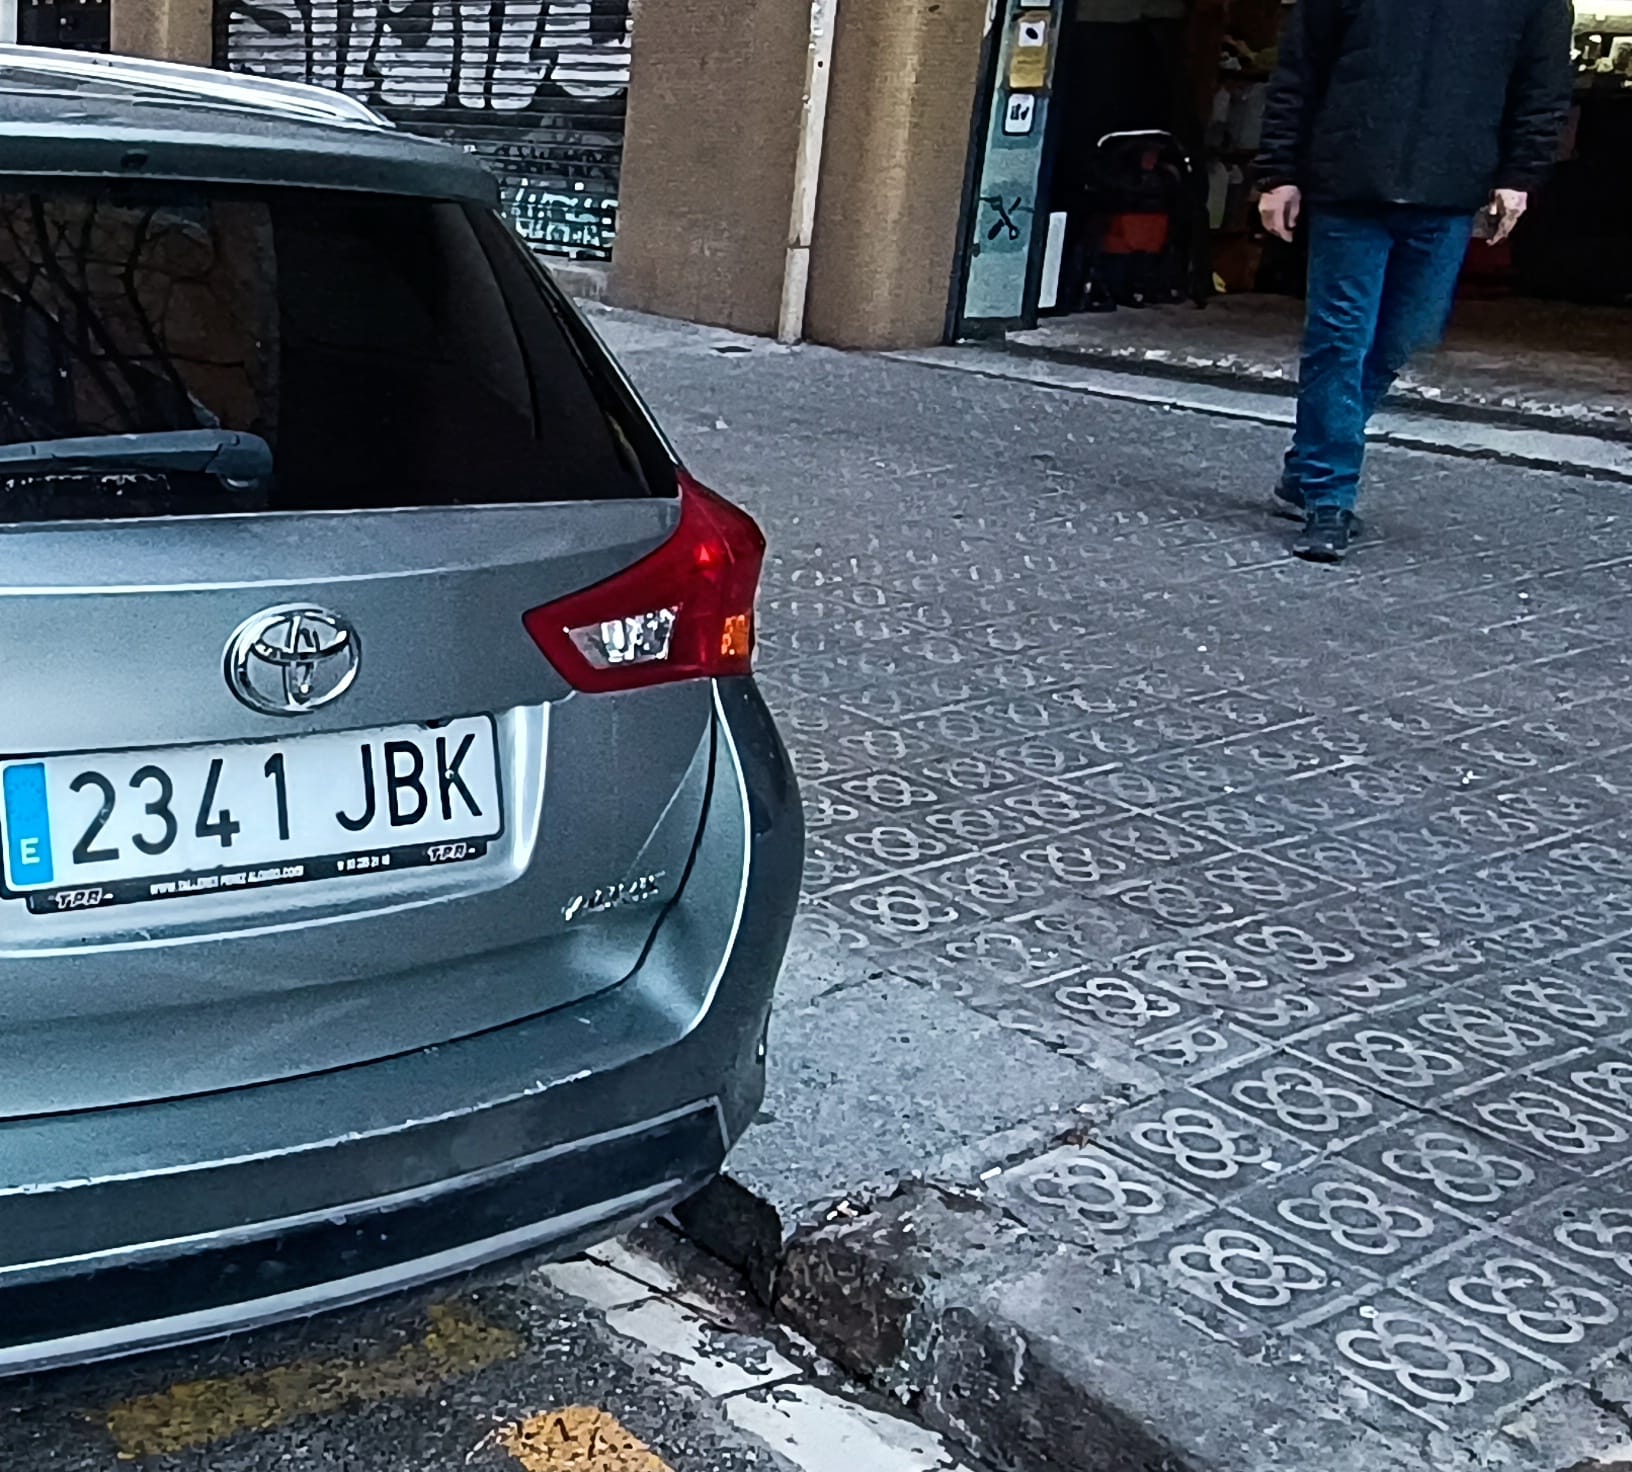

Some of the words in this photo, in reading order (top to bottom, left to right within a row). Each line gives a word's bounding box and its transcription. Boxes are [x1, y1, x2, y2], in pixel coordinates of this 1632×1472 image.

[69, 753, 290, 864] 2341
[335, 733, 483, 831] JBK
[20, 837, 41, 865] E
